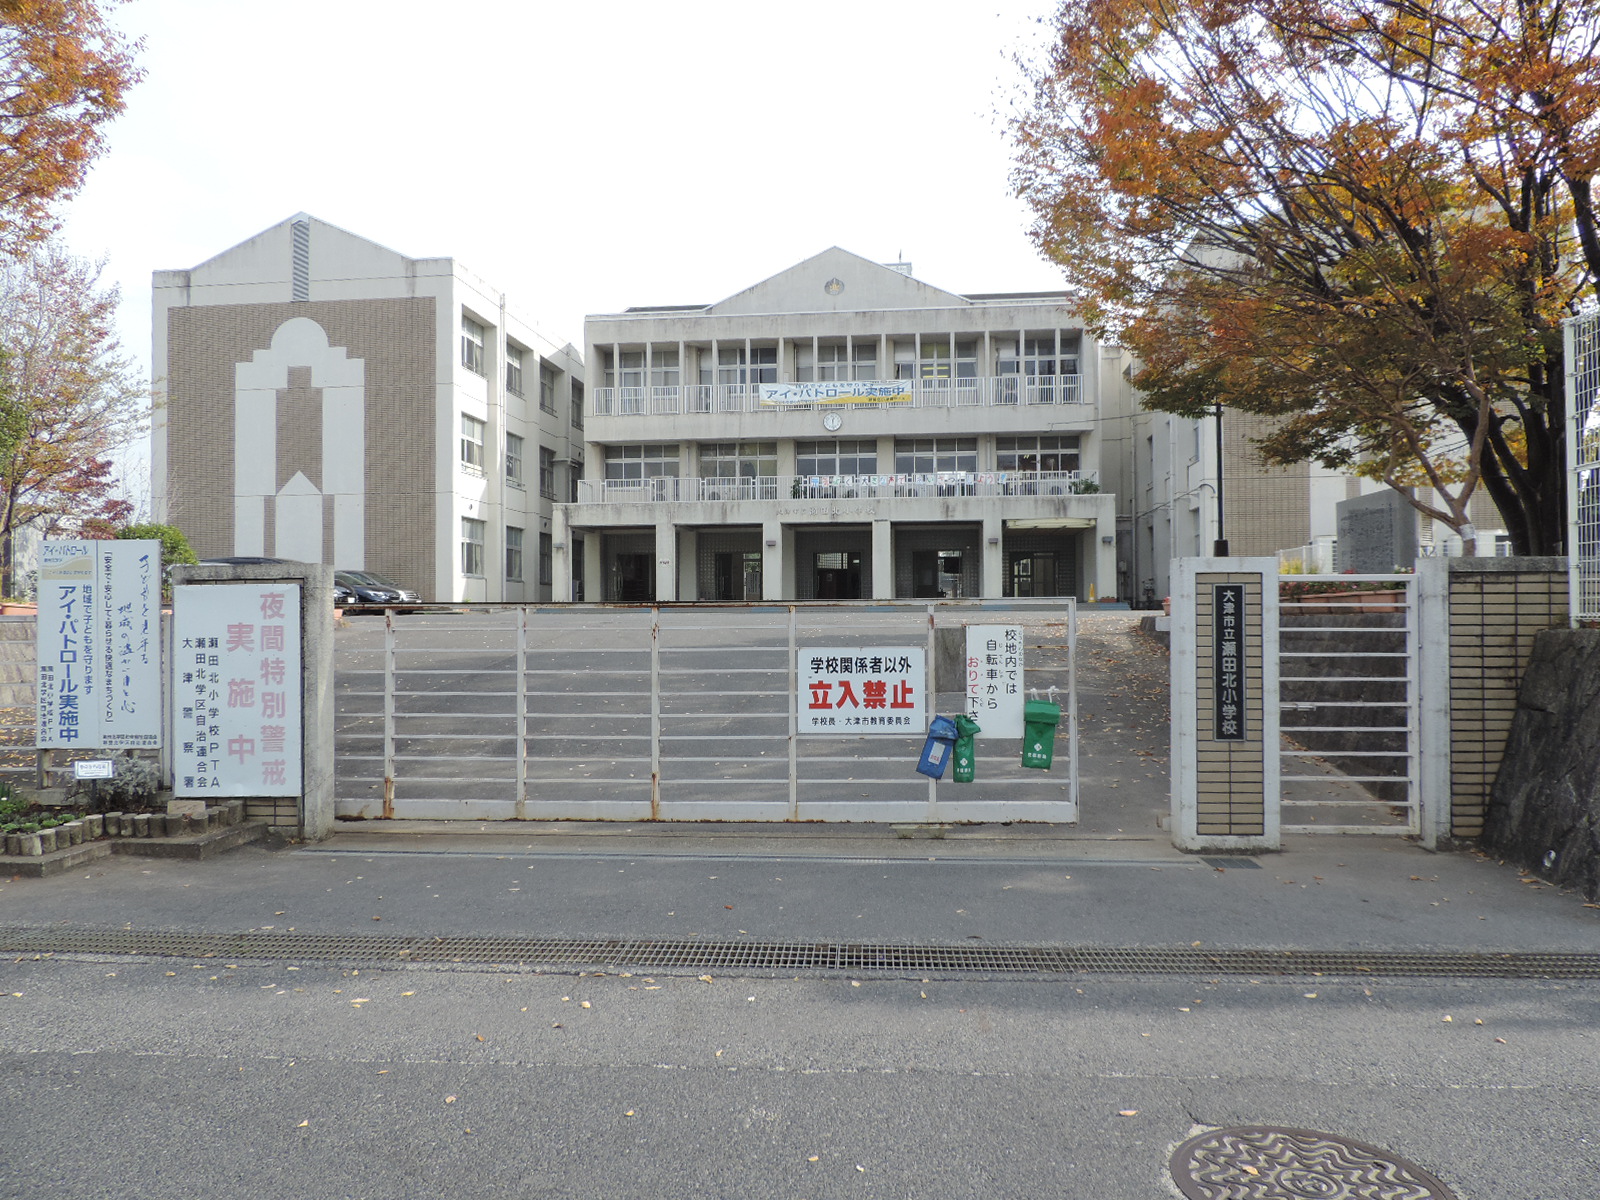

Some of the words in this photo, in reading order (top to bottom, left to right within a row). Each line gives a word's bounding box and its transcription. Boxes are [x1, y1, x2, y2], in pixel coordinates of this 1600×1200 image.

[766, 386, 906, 399] アイ・パトロール実施中
[43, 545, 89, 556] アイ・パトロール
[59, 586, 78, 742] アイ・パトロール実施中
[83, 584, 93, 695] 地域で子どもを守ります
[810, 656, 912, 674] 学校関係者以外
[986, 639, 999, 710] 自転車から
[1004, 629, 1018, 695] 校地内では
[1222, 590, 1237, 734] 大津市立瀬田北小学校
[182, 637, 193, 787] 大津警察署
[195, 637, 207, 788] 瀬田北学区自治連合会
[208, 636, 220, 788] 瀬田北小学校PTA
[227, 622, 255, 764] 実施中
[260, 592, 286, 785] 夜間特別警戒
[808, 680, 914, 709] 立入禁止
[811, 716, 911, 726] 学校長・大津市教育委員会
[967, 656, 980, 722] おりて下さ
